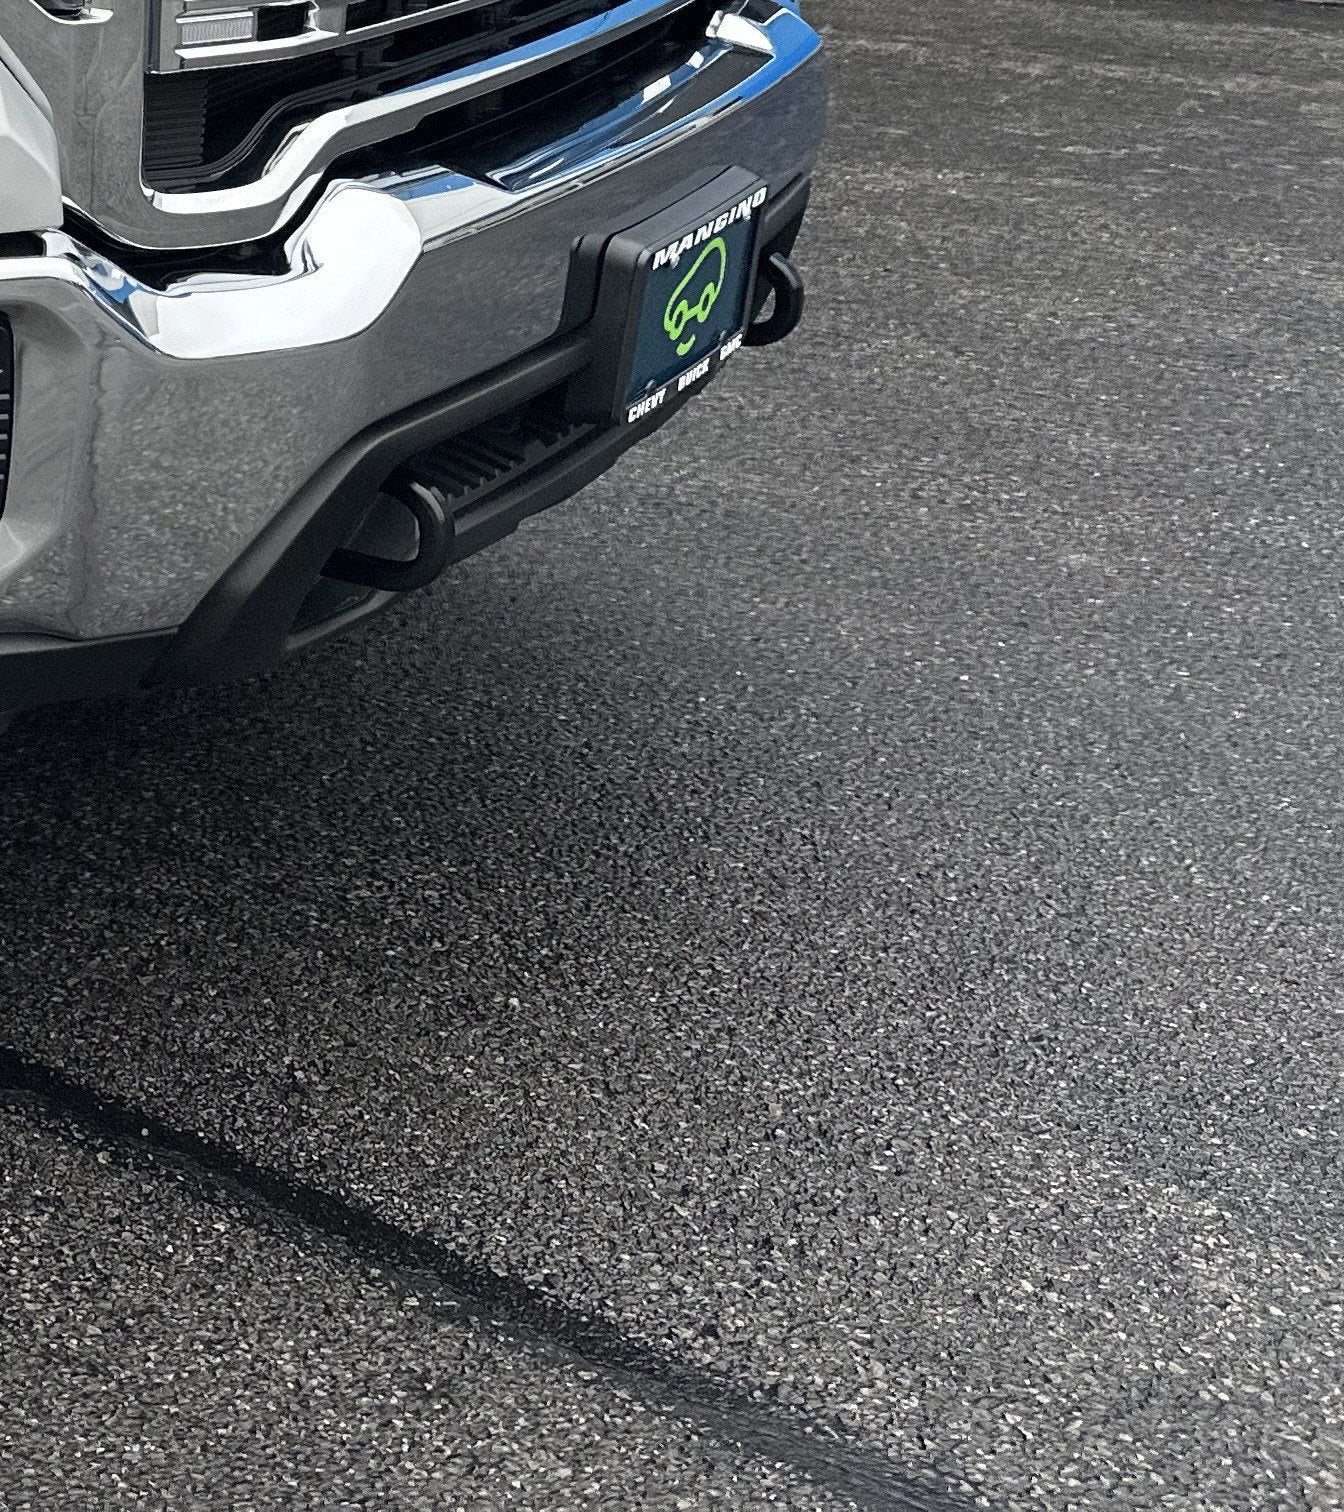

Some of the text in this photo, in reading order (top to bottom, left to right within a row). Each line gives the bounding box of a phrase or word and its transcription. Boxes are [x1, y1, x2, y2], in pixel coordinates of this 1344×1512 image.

[652, 186, 767, 271] MANGINO
[627, 333, 743, 424] CHEVY BUICK GMC
